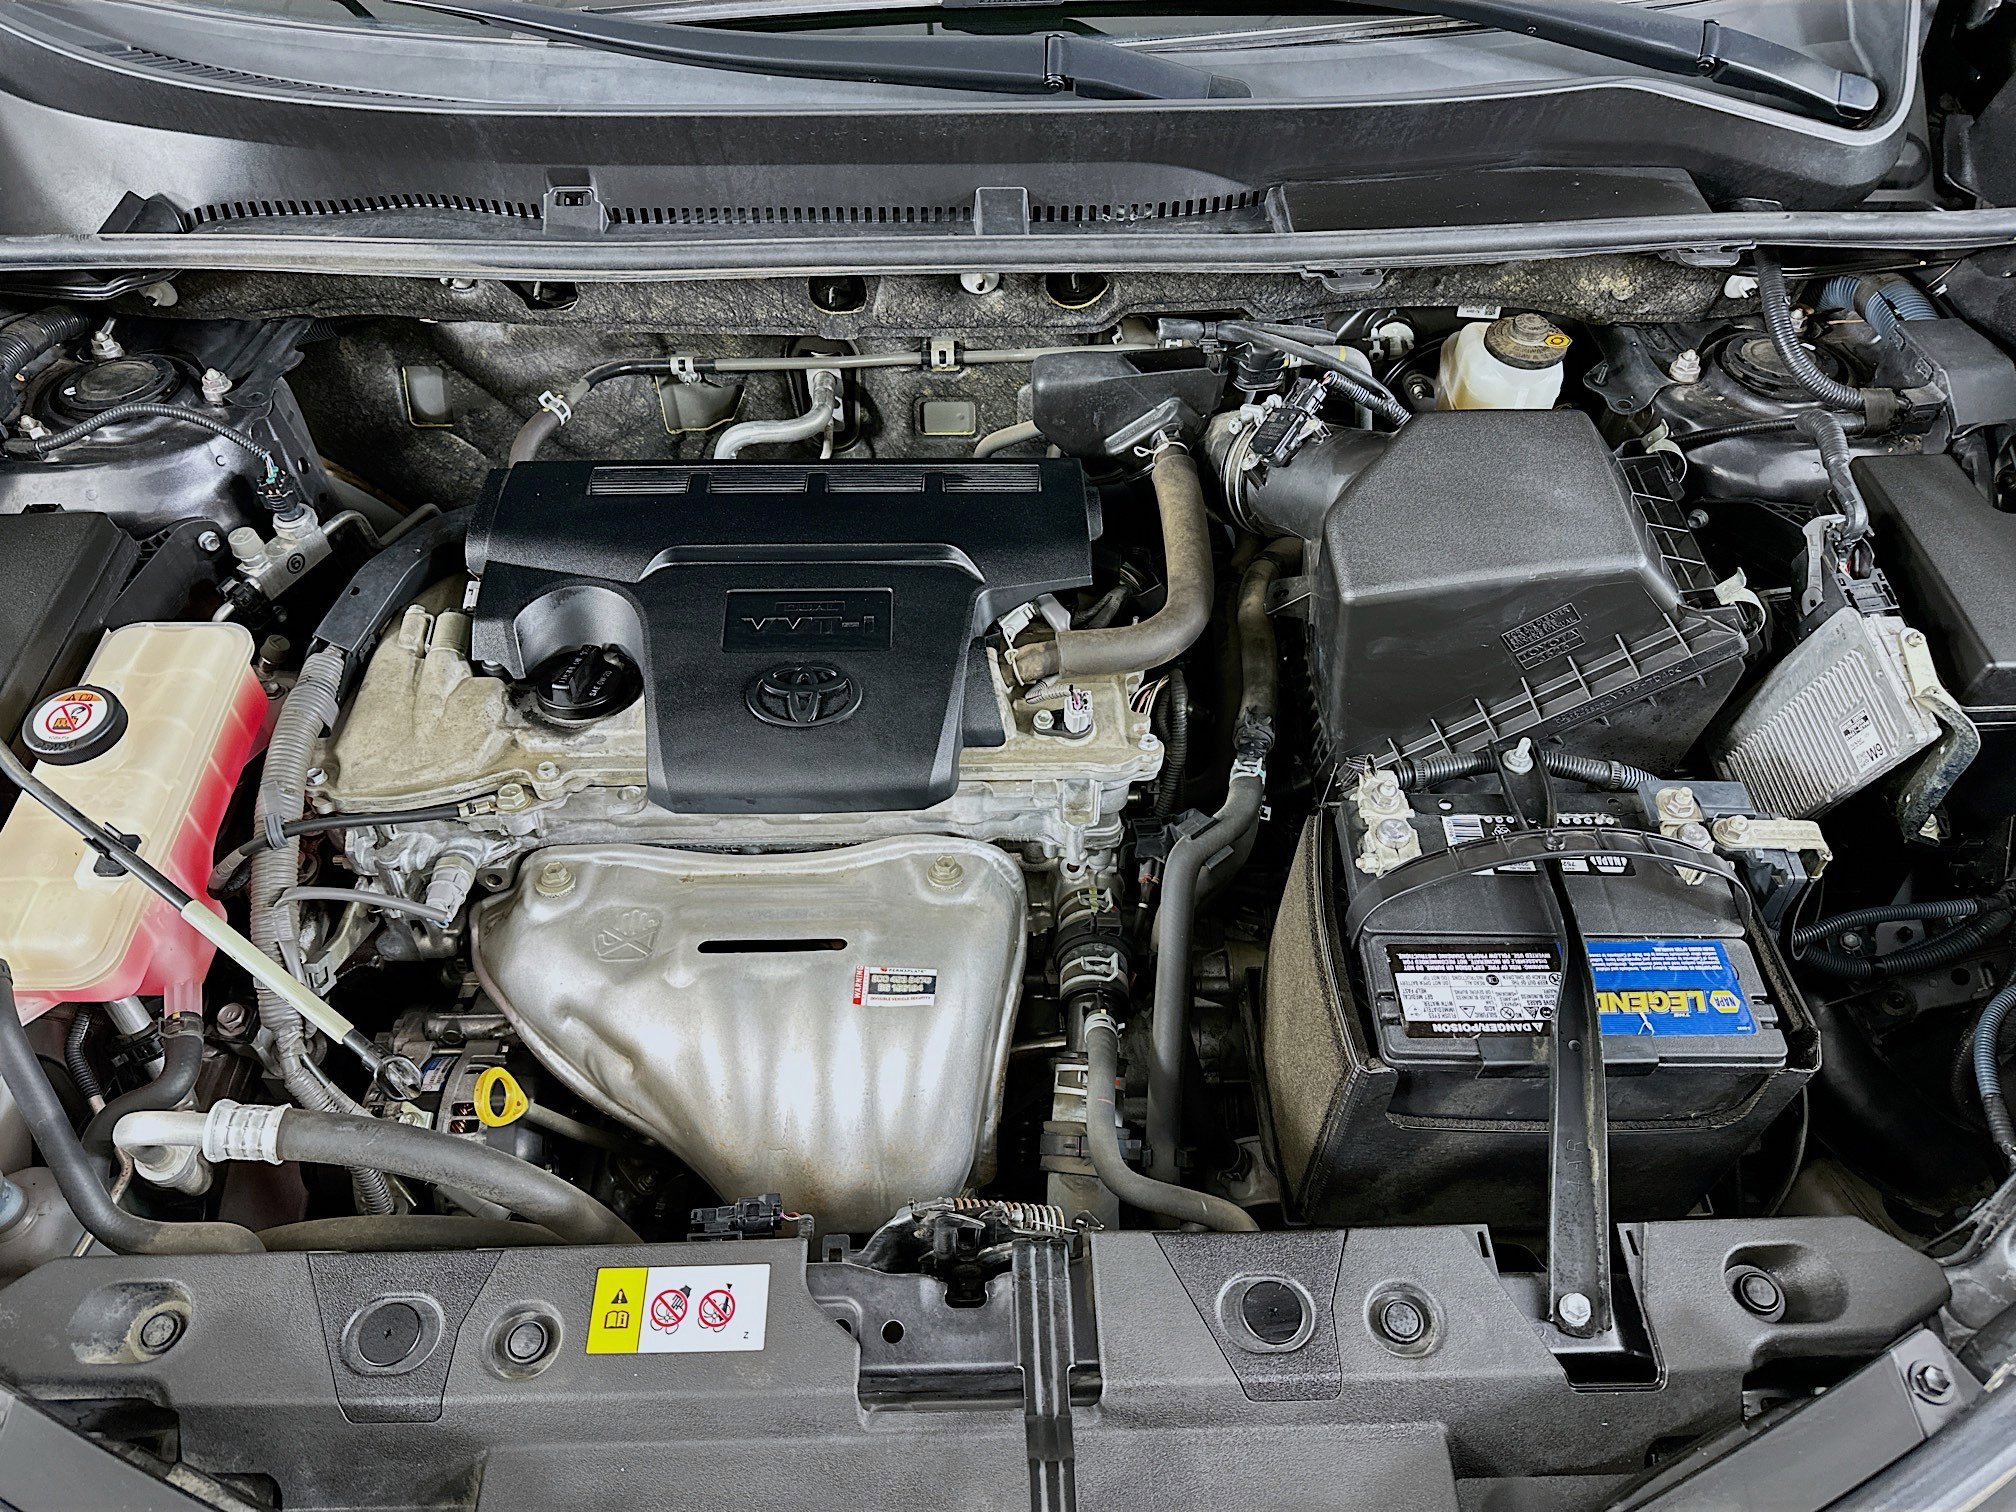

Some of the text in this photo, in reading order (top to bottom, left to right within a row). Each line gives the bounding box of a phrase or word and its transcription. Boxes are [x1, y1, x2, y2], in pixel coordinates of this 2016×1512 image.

[1520, 631, 1579, 659] TOYOTA
[588, 685, 601, 697] SAE
[1866, 743, 1884, 762] W9
[1595, 856, 1622, 866] NAPA
[854, 965, 864, 999] WARNING
[1714, 997, 1736, 1007] NAPA
[1432, 1021, 1532, 1033] DANGER/POISON
[743, 1331, 749, 1339] Z
